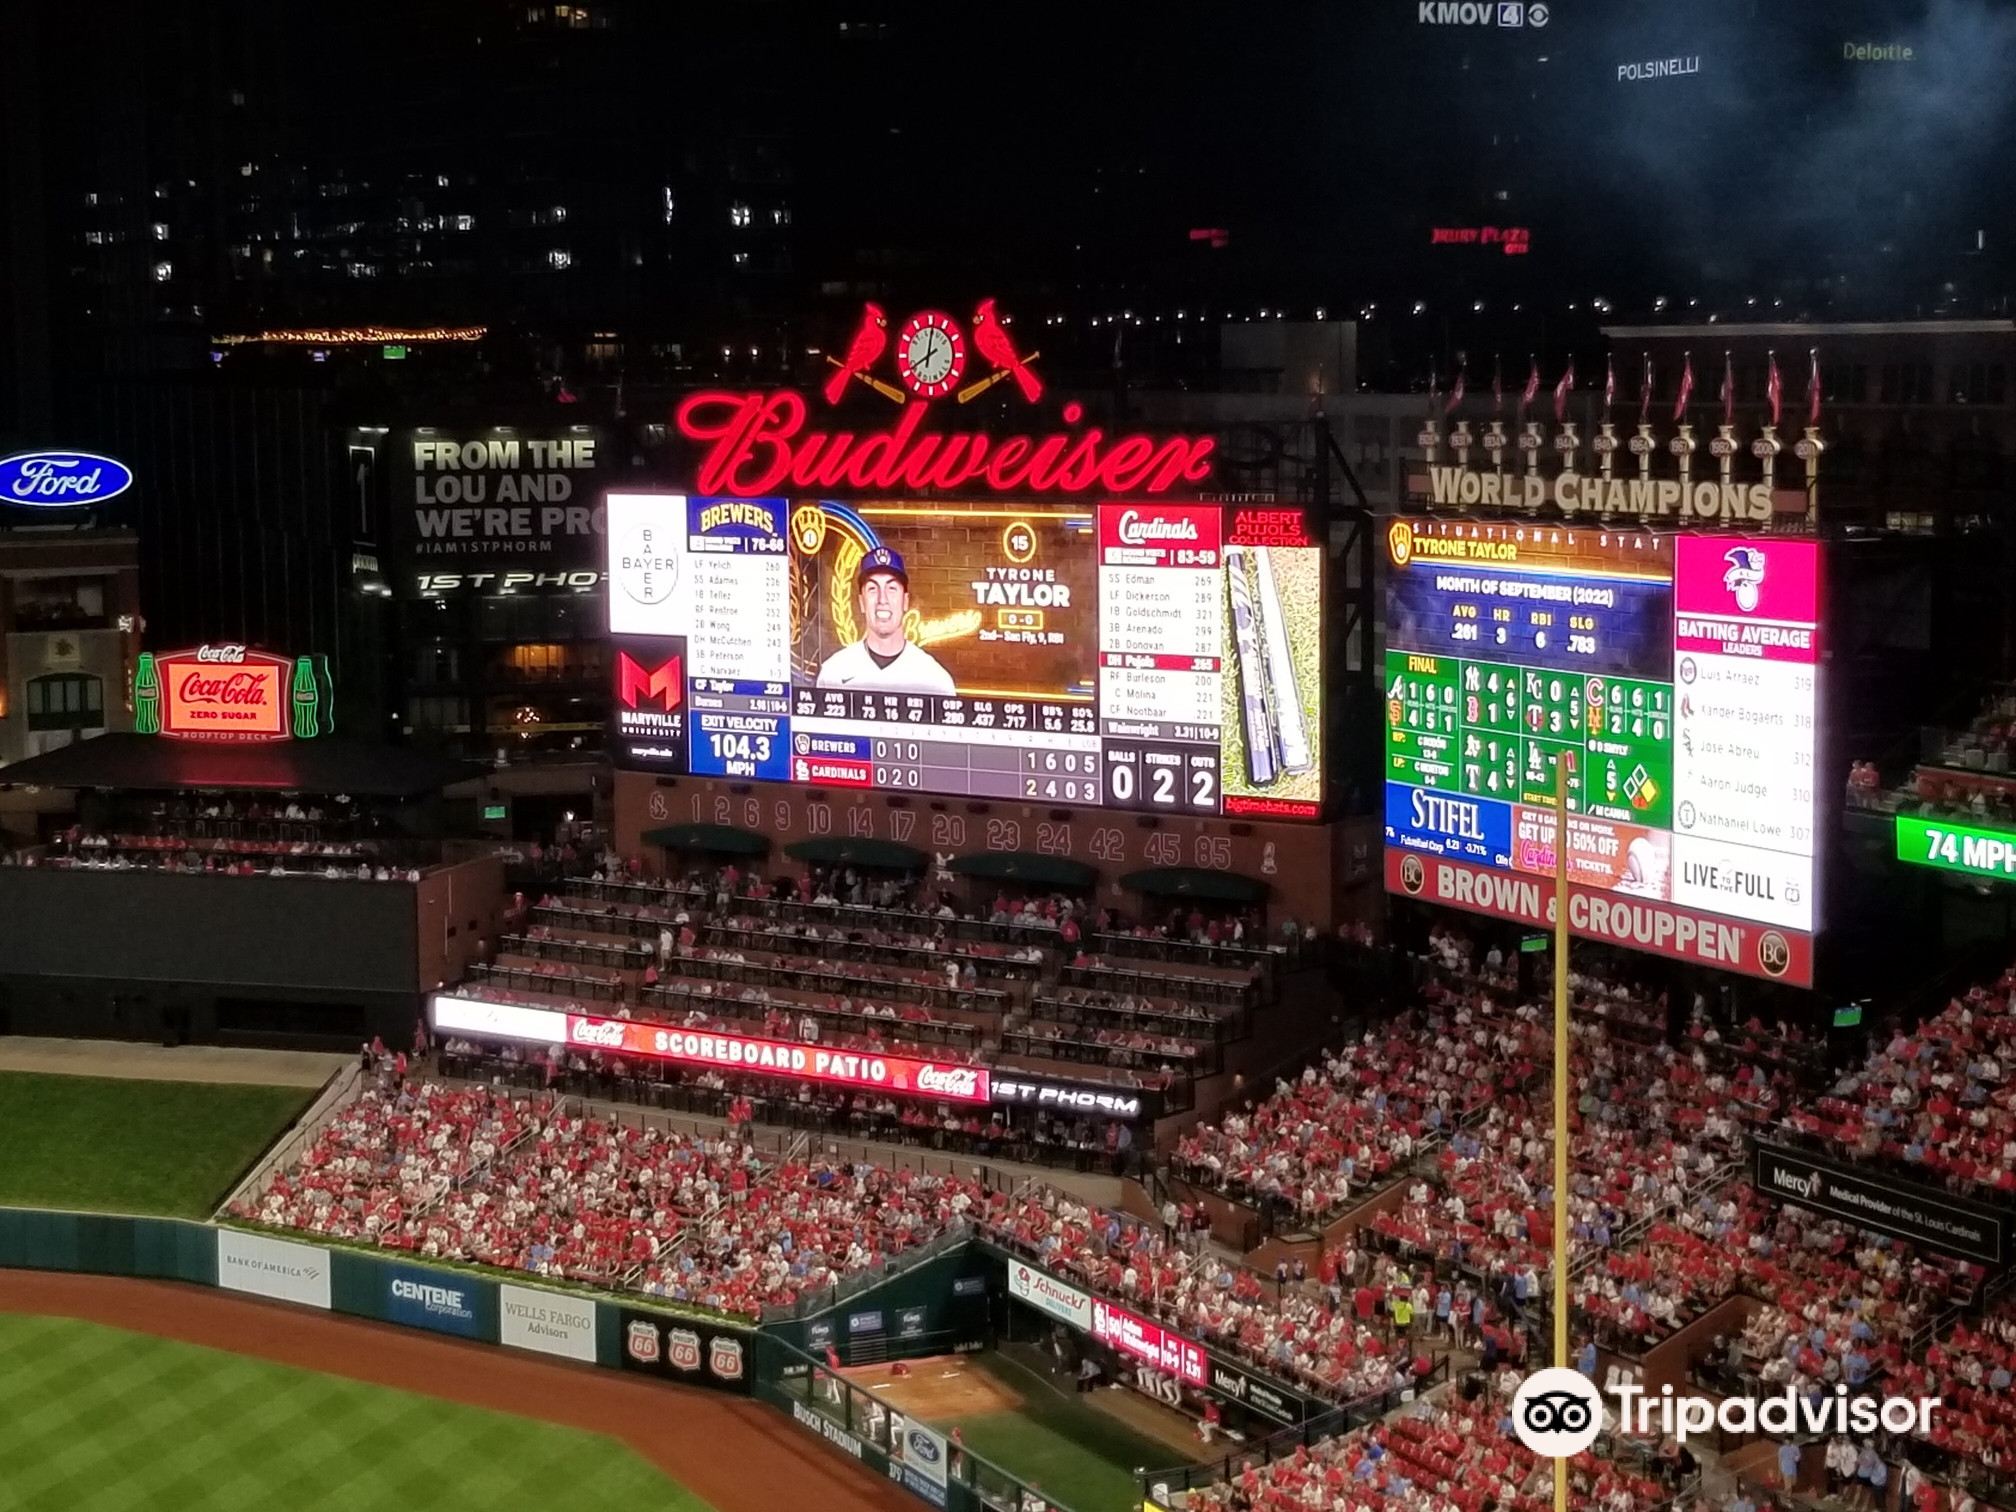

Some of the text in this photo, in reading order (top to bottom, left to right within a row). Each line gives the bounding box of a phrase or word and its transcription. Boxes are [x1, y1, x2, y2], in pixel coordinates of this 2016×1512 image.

[1418, 2, 1519, 26] KMOV 4
[1617, 55, 1699, 82] POLSINELLI
[414, 440, 596, 471] FROM THE
[678, 391, 1215, 496] Budweiser
[11, 458, 102, 497] Ford
[415, 473, 572, 504] LOU AND
[1431, 466, 1773, 520] WORLD CHAMPIONS
[416, 507, 532, 537] WE'RE
[700, 503, 774, 536] BREWERS
[1118, 510, 1198, 545] Cardinals
[1235, 511, 1303, 525] ALBERT
[1236, 524, 1302, 537] PUJOLS
[1010, 536, 1029, 550] 15
[1228, 535, 1309, 547] COLLECTION
[1413, 523, 1661, 551] SITUATIONAL STAT
[1413, 538, 1517, 561] TYRONE TAYLOR
[622, 556, 674, 571] BAYER
[985, 567, 1056, 583] TYRONE
[417, 573, 496, 590] 1ST
[1125, 573, 1155, 585] Edman
[1436, 575, 1614, 608] MONTH OF SEPTEMBER (2022)
[971, 581, 1071, 608] TAYLOR
[1125, 590, 1171, 602] Dickerson
[1125, 606, 1182, 619] Goldschmidt
[1452, 604, 1594, 631] AVG HR RBI SLG
[1125, 623, 1164, 635] Arenado
[1677, 619, 1811, 650] BATTING AVERAGE
[196, 644, 247, 664] Coca-Cola
[1125, 639, 1165, 651] Donovan
[1722, 641, 1763, 657] LEADERS
[1125, 654, 1156, 670] Pujols
[1408, 655, 1438, 674] FINAL
[1126, 672, 1166, 684] Burleson
[1126, 689, 1156, 700] Molina
[189, 710, 258, 722] ZERO SUGAR
[621, 711, 682, 728] MARYVILLE
[701, 714, 779, 732] EXIT VELOCITY
[1126, 705, 1167, 718] Nootbaar
[238, 732, 268, 742] DECK
[710, 733, 770, 761] 104.3
[811, 739, 856, 754] BREWERS
[1107, 750, 1216, 768] BALLS STRIKES OUTS
[1728, 743, 1760, 760] Abreu
[725, 760, 756, 777] MPH
[811, 765, 867, 781] CARDINALS
[1112, 765, 1215, 806] 0 2 2
[1700, 775, 1768, 799] Aaron Judge
[690, 793, 701, 823] 1
[713, 795, 731, 826] 2
[743, 798, 760, 828] 6
[774, 800, 791, 831] 9
[806, 803, 832, 834] 10
[1410, 788, 1486, 841] STIFEL
[847, 806, 874, 839] 14
[888, 809, 917, 842] 17
[931, 813, 966, 847] 20
[985, 818, 1021, 852] 23
[1699, 811, 1782, 836] Nathaniel Lowe
[1036, 822, 1072, 857] 24
[1088, 827, 1126, 862] 42
[1143, 831, 1182, 866] 45
[1194, 835, 1232, 870] 85
[1518, 821, 1539, 844] GET
[1540, 827, 1556, 845] UP
[1572, 832, 1598, 854] 50%
[1598, 835, 1620, 857] OFF
[1925, 829, 1959, 864] 74
[1683, 861, 1775, 901] LIVE FULL
[1437, 864, 1540, 919] BROWN
[1568, 893, 1741, 965] CROUPPEN
[1761, 942, 1787, 967] BC
[572, 1017, 979, 1097] Coca-Cola SCOREBOARD PATIO Coca-Cola
[990, 1080, 1137, 1114] 1ST PHORM
[1772, 1167, 1812, 1198] Mercy
[1829, 1185, 1860, 1205] Medical
[1859, 1193, 1892, 1217] Provider
[1892, 1206, 1901, 1217] of
[1901, 1209, 1914, 1223] the
[1924, 1215, 1945, 1232] Louis
[1944, 1221, 1982, 1243] Cardinals
[226, 1254, 302, 1278] BANK OF AMERICA
[391, 1278, 463, 1309] CENTENE
[1033, 1277, 1087, 1311] Schnucks
[424, 1302, 473, 1320] Corporation
[505, 1301, 591, 1332] WELLS FARGO
[527, 1321, 569, 1340] Advisors
[633, 1337, 652, 1354] 66
[674, 1345, 693, 1361] 66
[716, 1354, 735, 1371] 66
[1214, 1369, 1241, 1398] Mercy
[793, 1400, 862, 1460] BUSCH STADIUM
